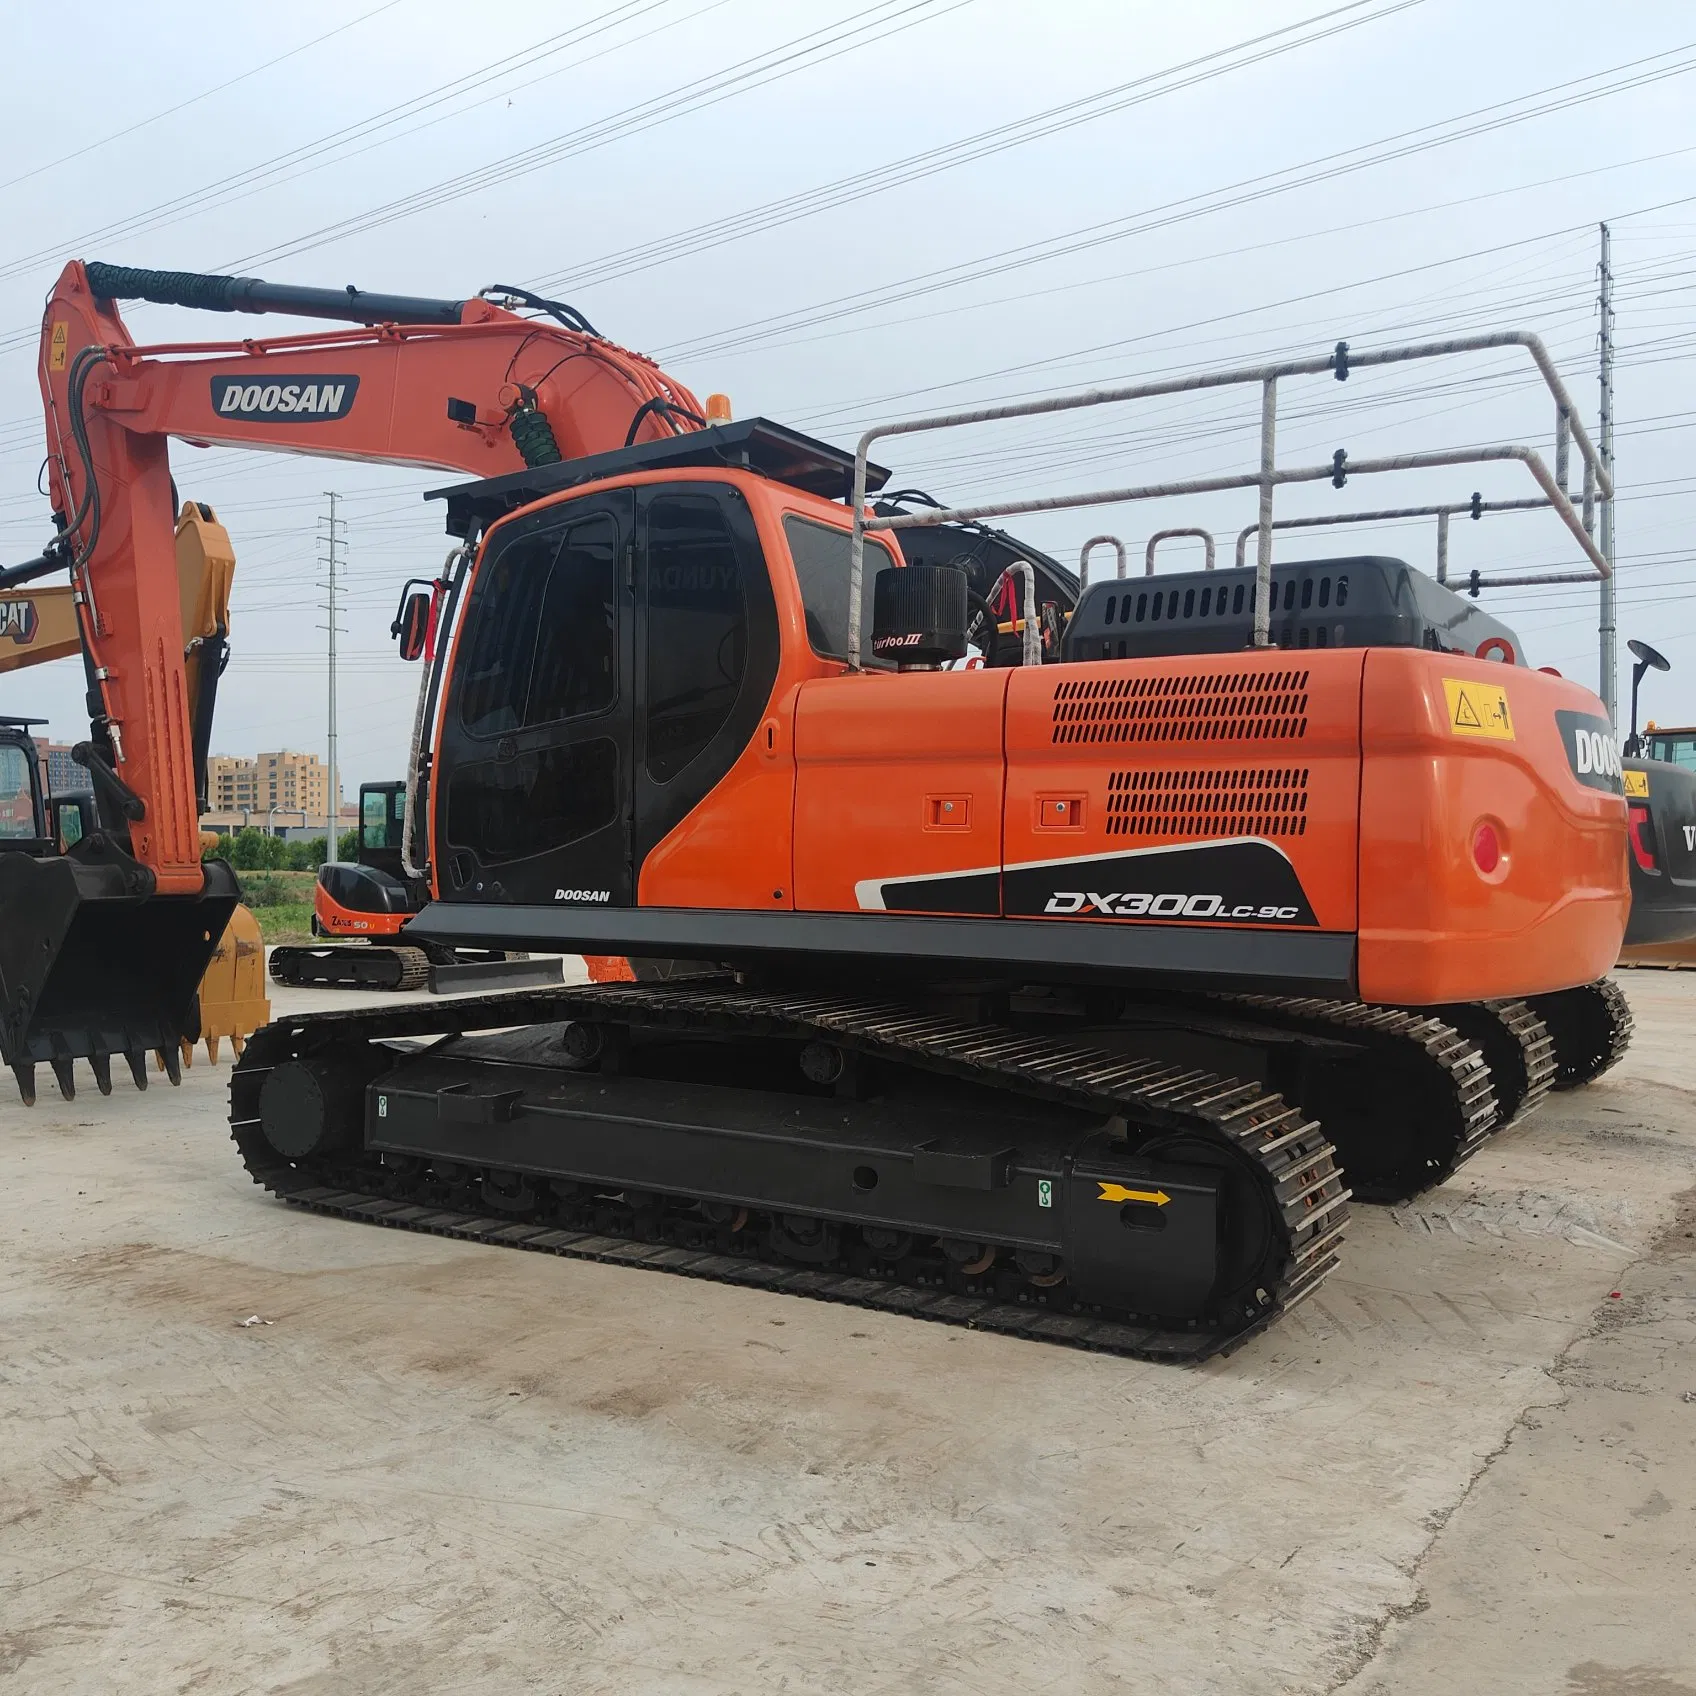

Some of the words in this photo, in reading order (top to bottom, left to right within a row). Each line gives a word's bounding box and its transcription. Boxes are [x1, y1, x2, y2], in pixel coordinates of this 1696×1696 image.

[220, 385, 346, 413] DOOSAN
[0, 602, 29, 635] CAT
[1575, 729, 1623, 779] DOOS
[1682, 825, 1696, 851] V
[554, 888, 611, 902] DOOSAN
[353, 921, 368, 929] 50
